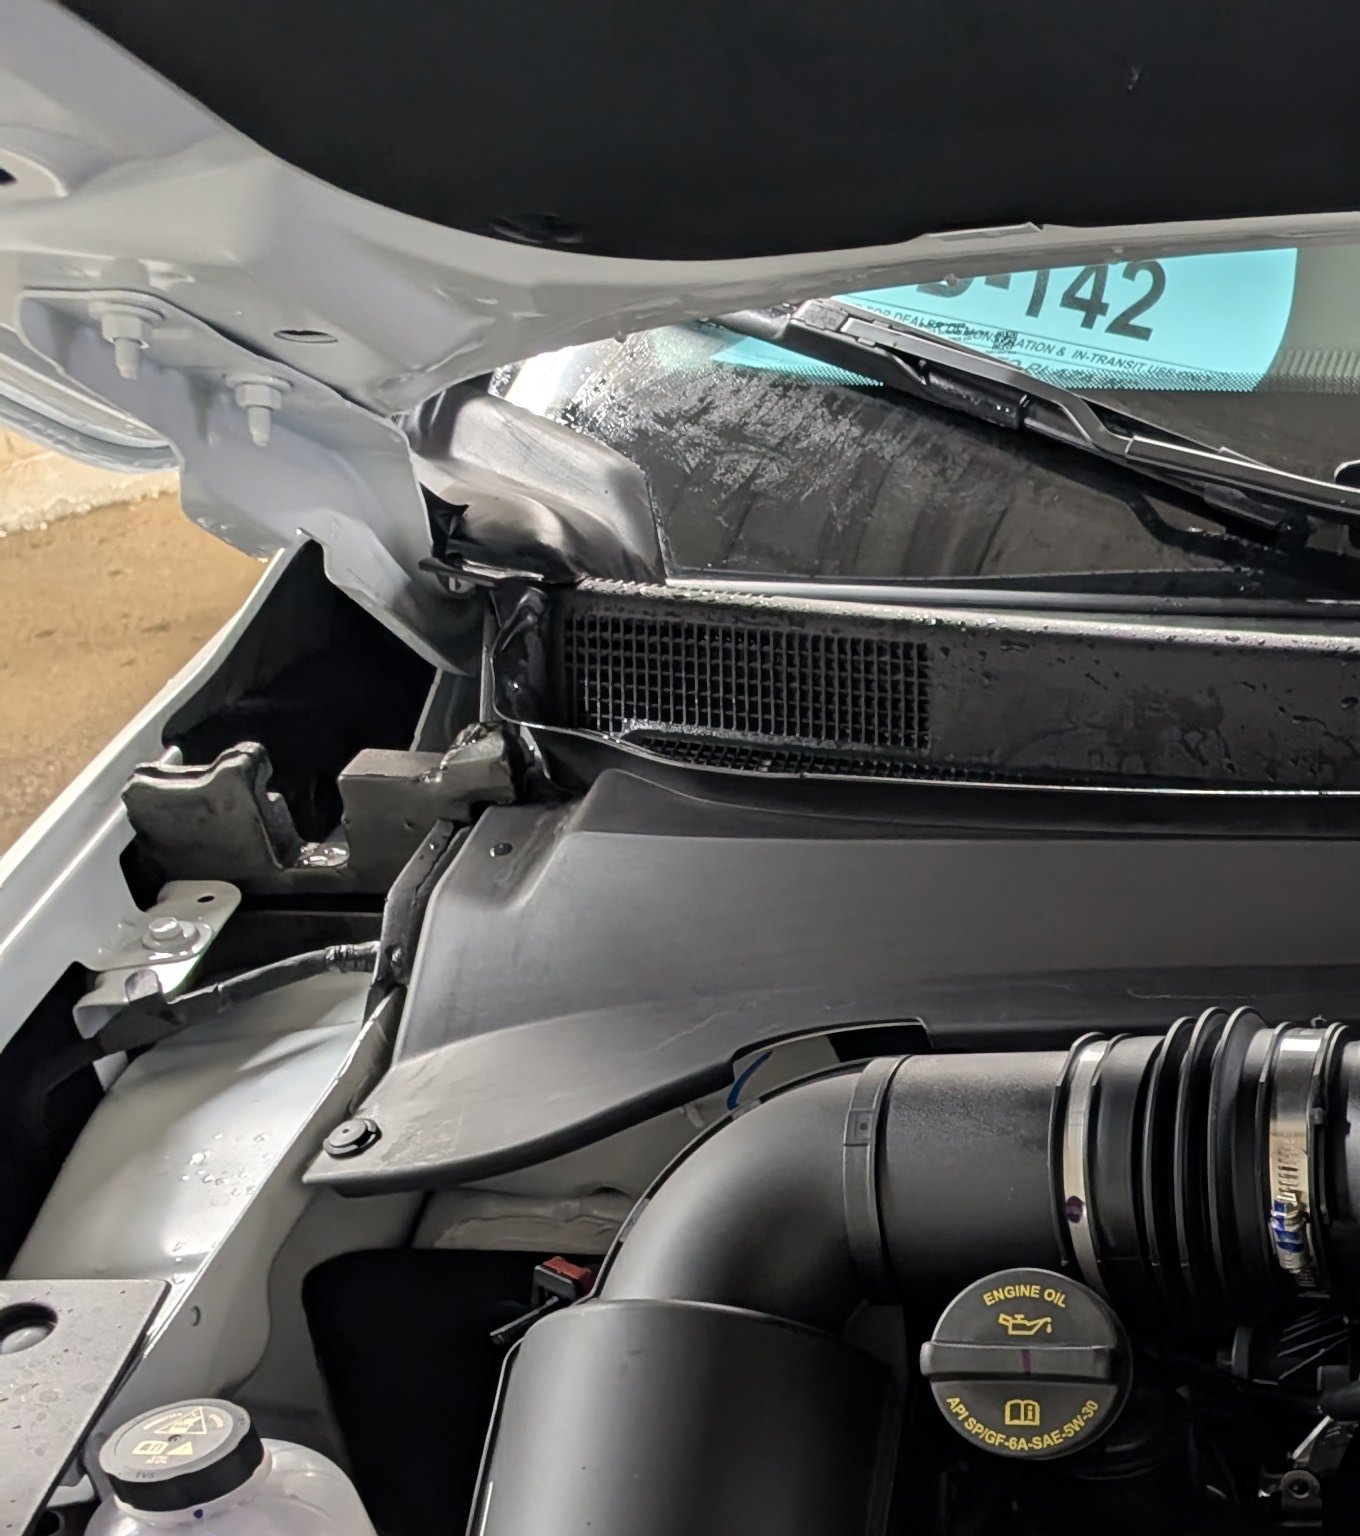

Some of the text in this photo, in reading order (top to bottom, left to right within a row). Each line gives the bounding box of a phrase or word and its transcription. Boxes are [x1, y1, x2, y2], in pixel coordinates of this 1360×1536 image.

[1055, 346, 1065, 357] &
[1072, 349, 1147, 373] IN-TRANSIT
[983, 1285, 1066, 1308] ENGINE OIL
[947, 1397, 969, 1420] API
